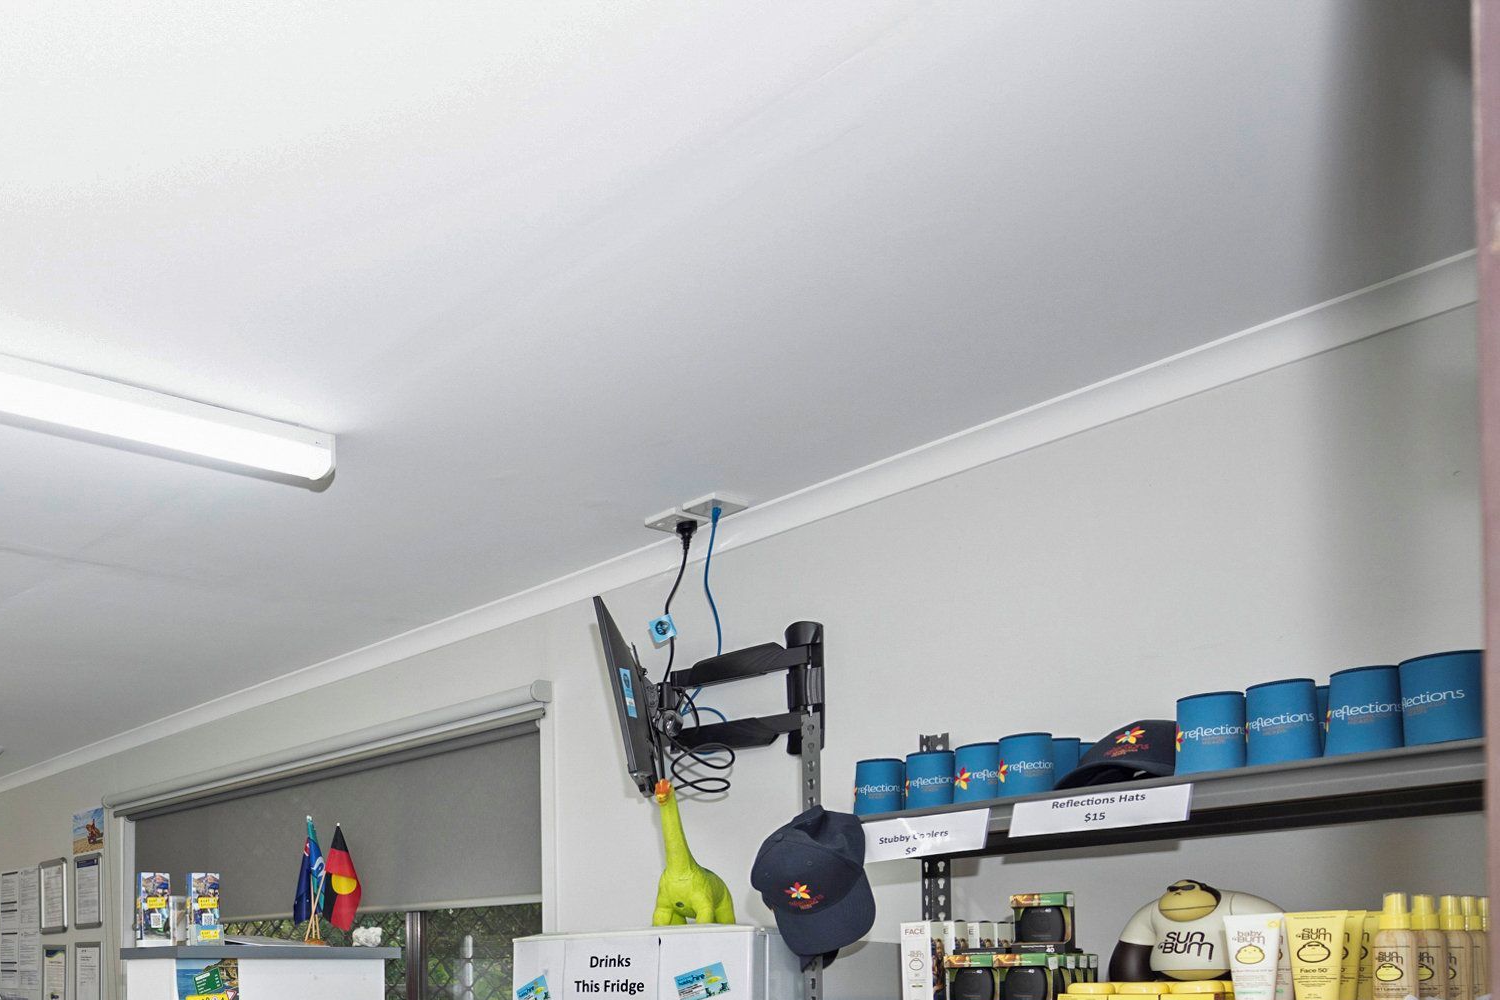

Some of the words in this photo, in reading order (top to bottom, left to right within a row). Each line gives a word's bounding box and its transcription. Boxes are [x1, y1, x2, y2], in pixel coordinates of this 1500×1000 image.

[1249, 711, 1314, 731] reflections
[1052, 796, 1115, 809] Reflections
[1118, 792, 1146, 802] Hats
[1084, 812, 1106, 822] $15
[879, 833, 911, 844] Stubby
[590, 954, 631, 968] Drinks
[574, 980, 600, 992] This
[604, 979, 645, 995] Fridge
